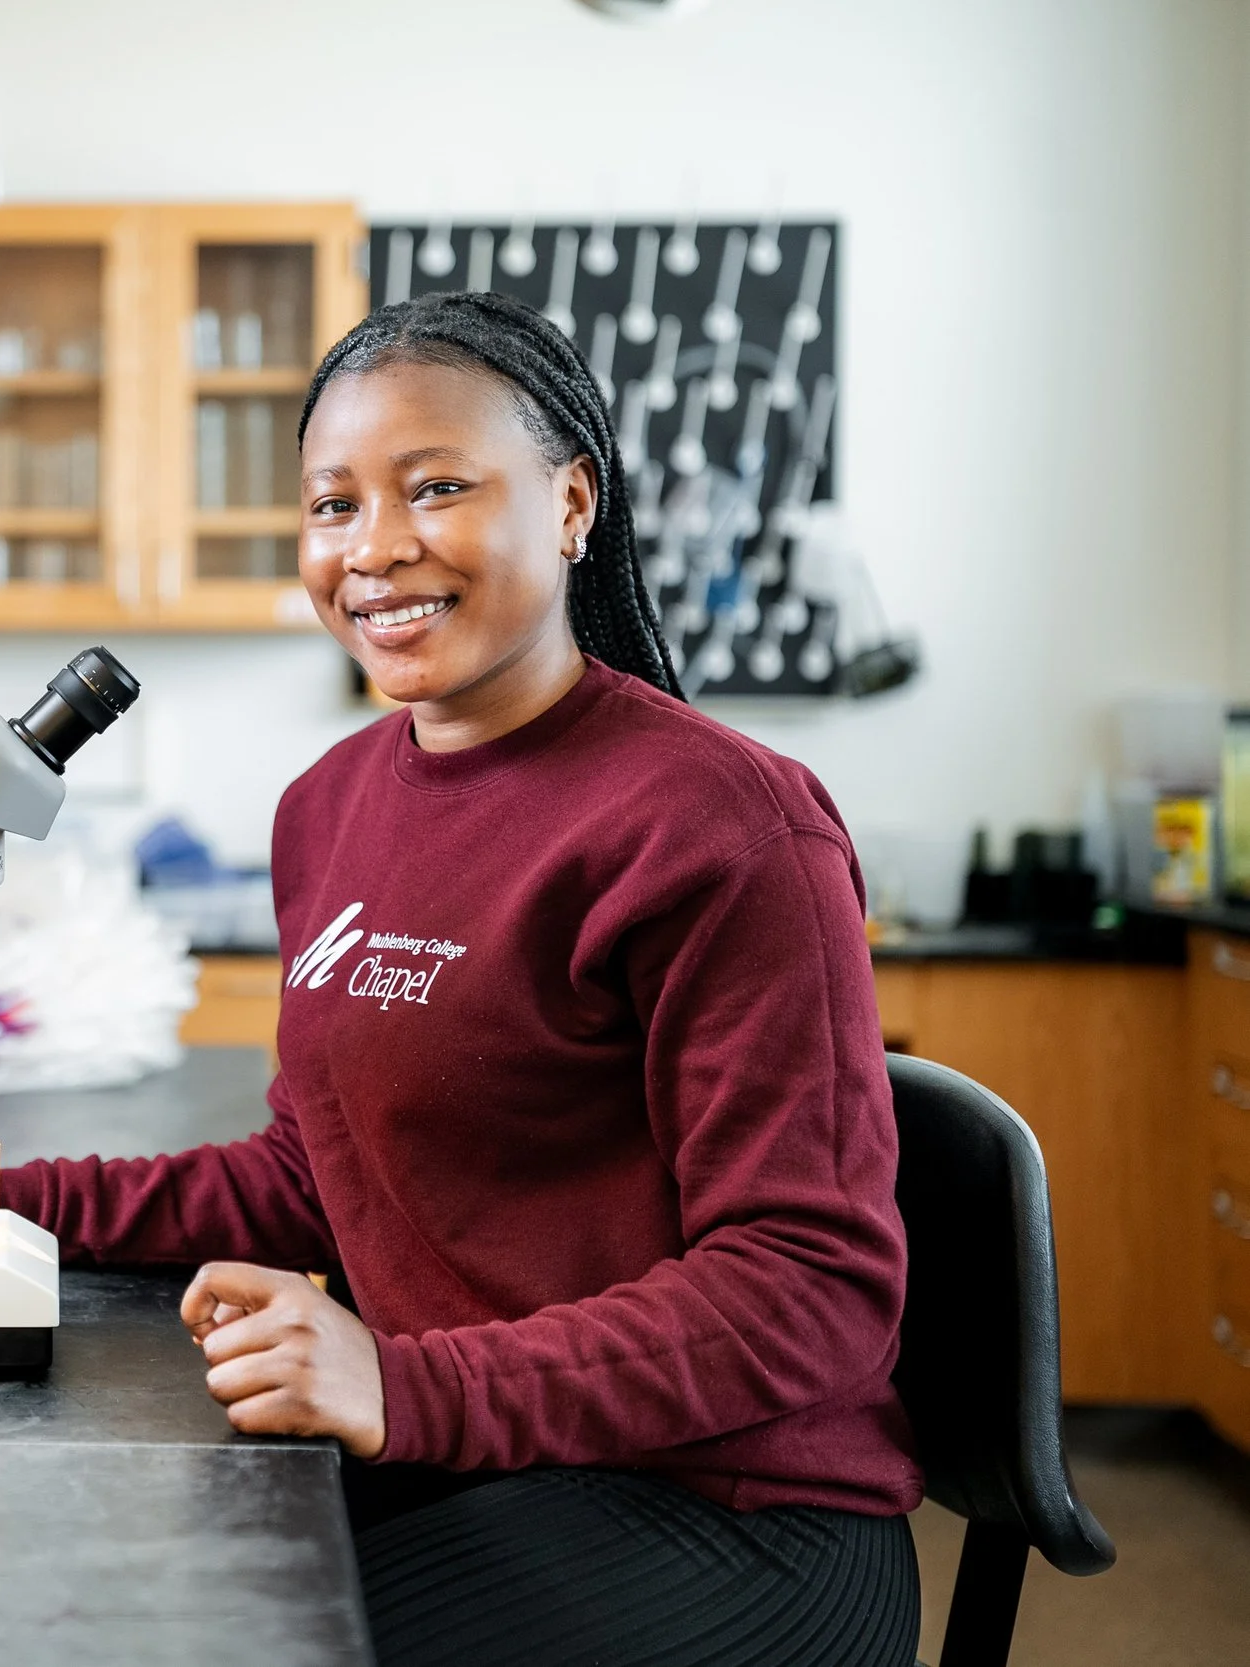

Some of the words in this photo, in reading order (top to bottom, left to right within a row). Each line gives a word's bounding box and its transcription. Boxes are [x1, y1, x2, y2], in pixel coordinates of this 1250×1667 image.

[366, 932, 426, 956] Muhlenberg
[424, 938, 467, 961] College
[347, 955, 443, 1011] Chapel
